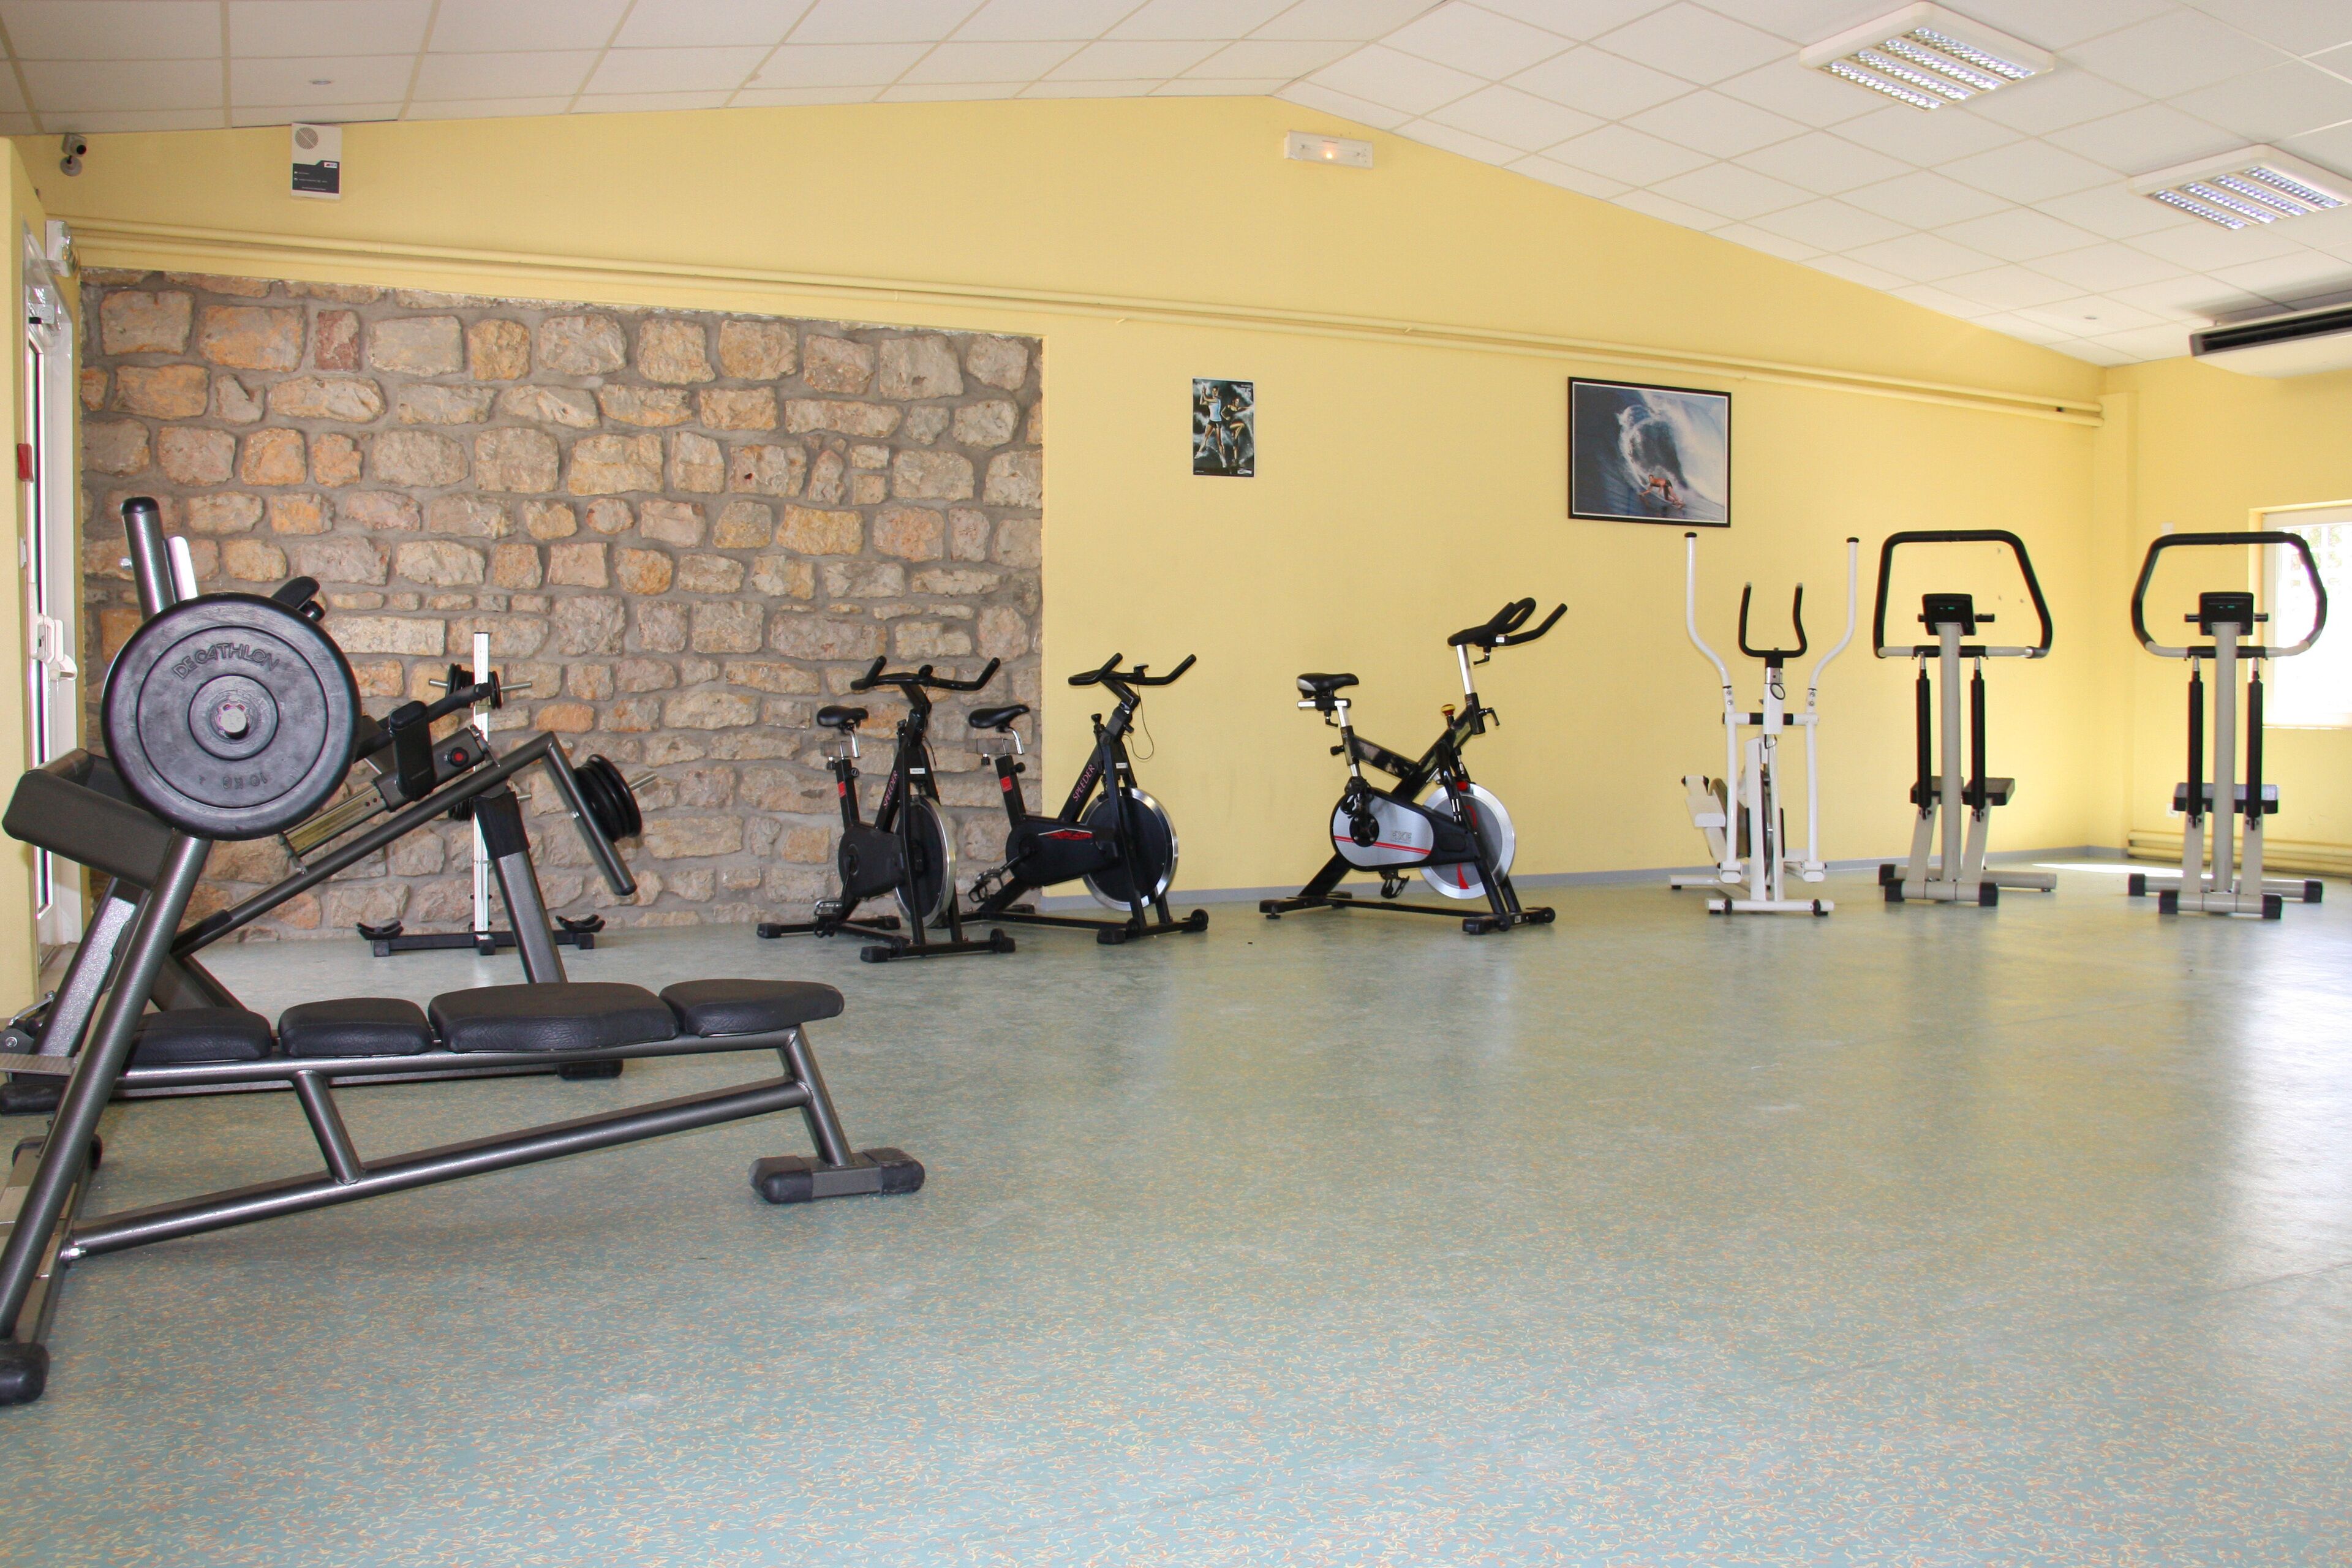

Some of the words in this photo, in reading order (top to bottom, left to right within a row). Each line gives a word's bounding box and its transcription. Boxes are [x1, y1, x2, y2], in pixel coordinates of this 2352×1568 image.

[172, 643, 280, 679] DECATHLON
[883, 770, 898, 809] SPEEDER
[1072, 764, 1095, 802] SPEEDER
